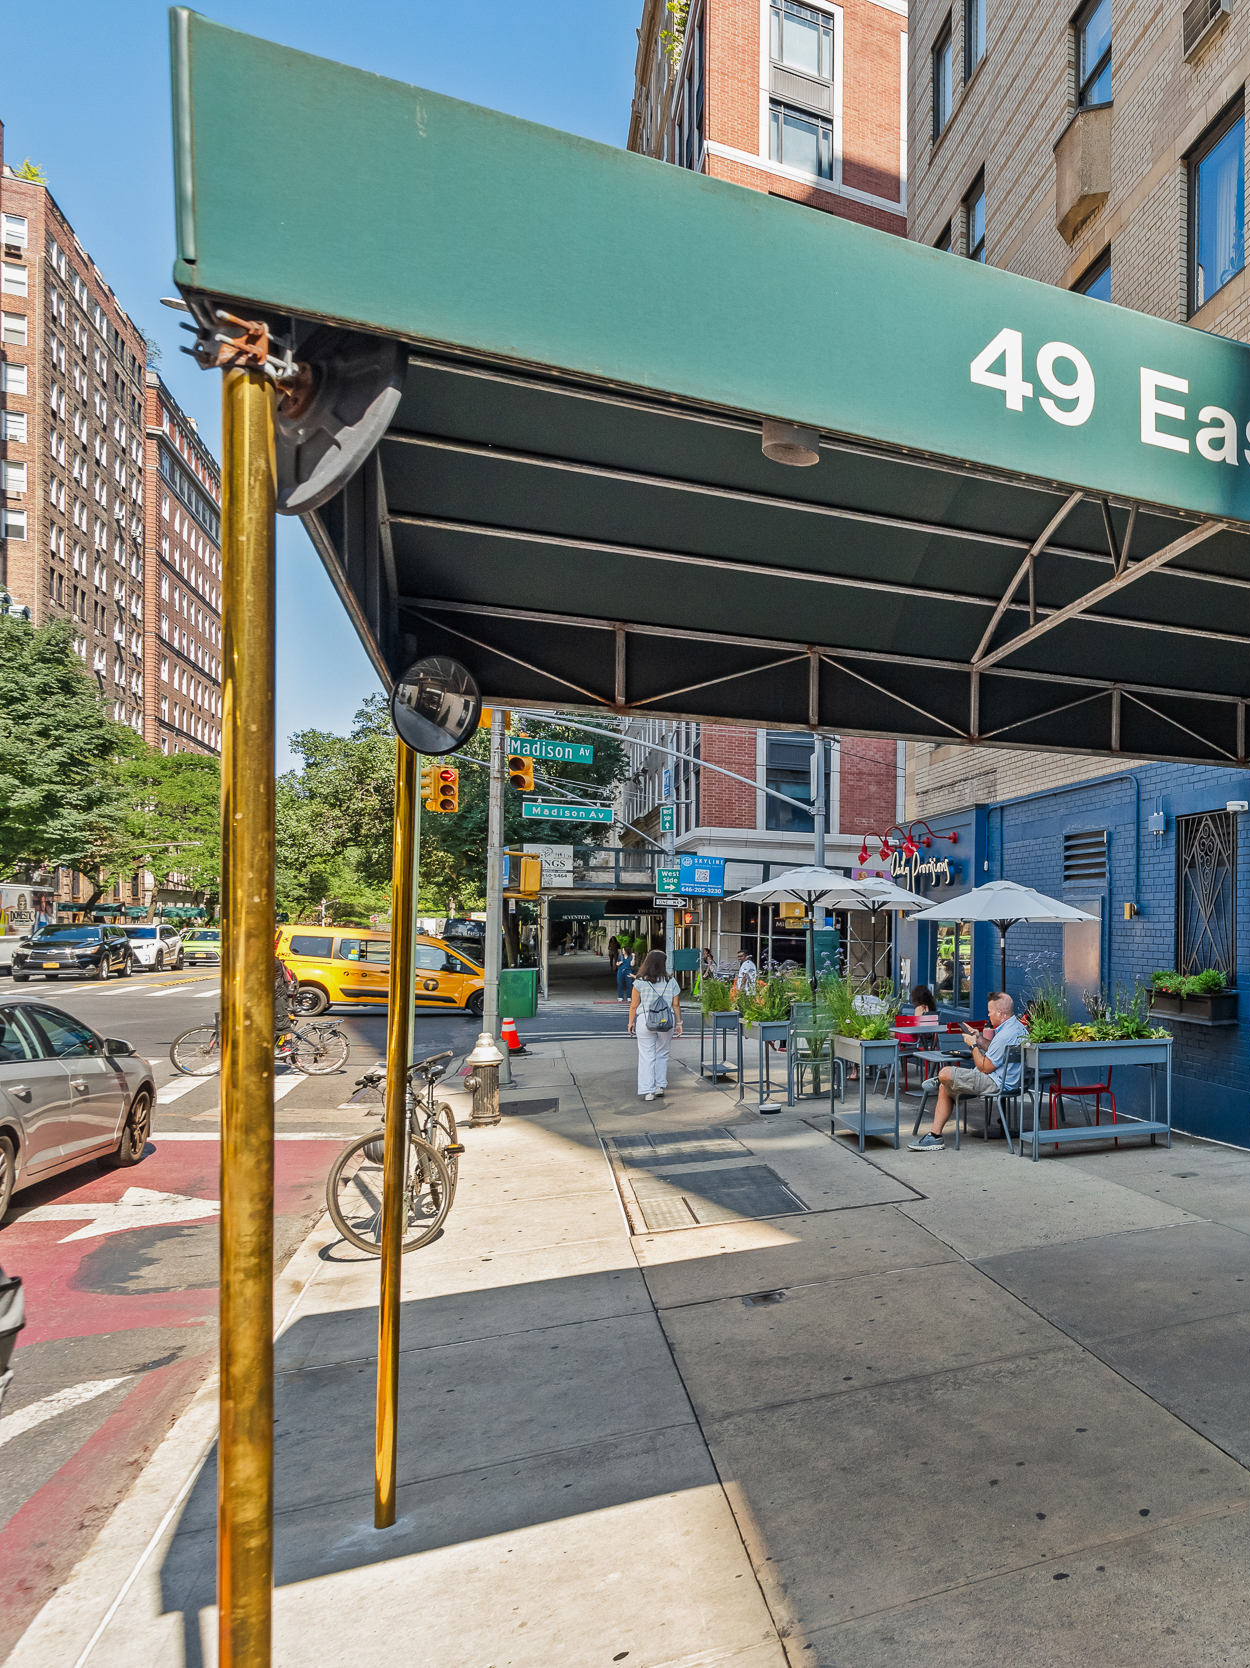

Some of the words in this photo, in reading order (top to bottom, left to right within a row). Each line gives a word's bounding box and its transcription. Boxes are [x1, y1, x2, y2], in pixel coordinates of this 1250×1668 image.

[969, 327, 1096, 427] 49
[510, 739, 573, 760] Madison
[579, 747, 590, 757] Av
[532, 806, 586, 818] Madison
[589, 810, 604, 819] Av
[694, 858, 724, 866] SKYLINE
